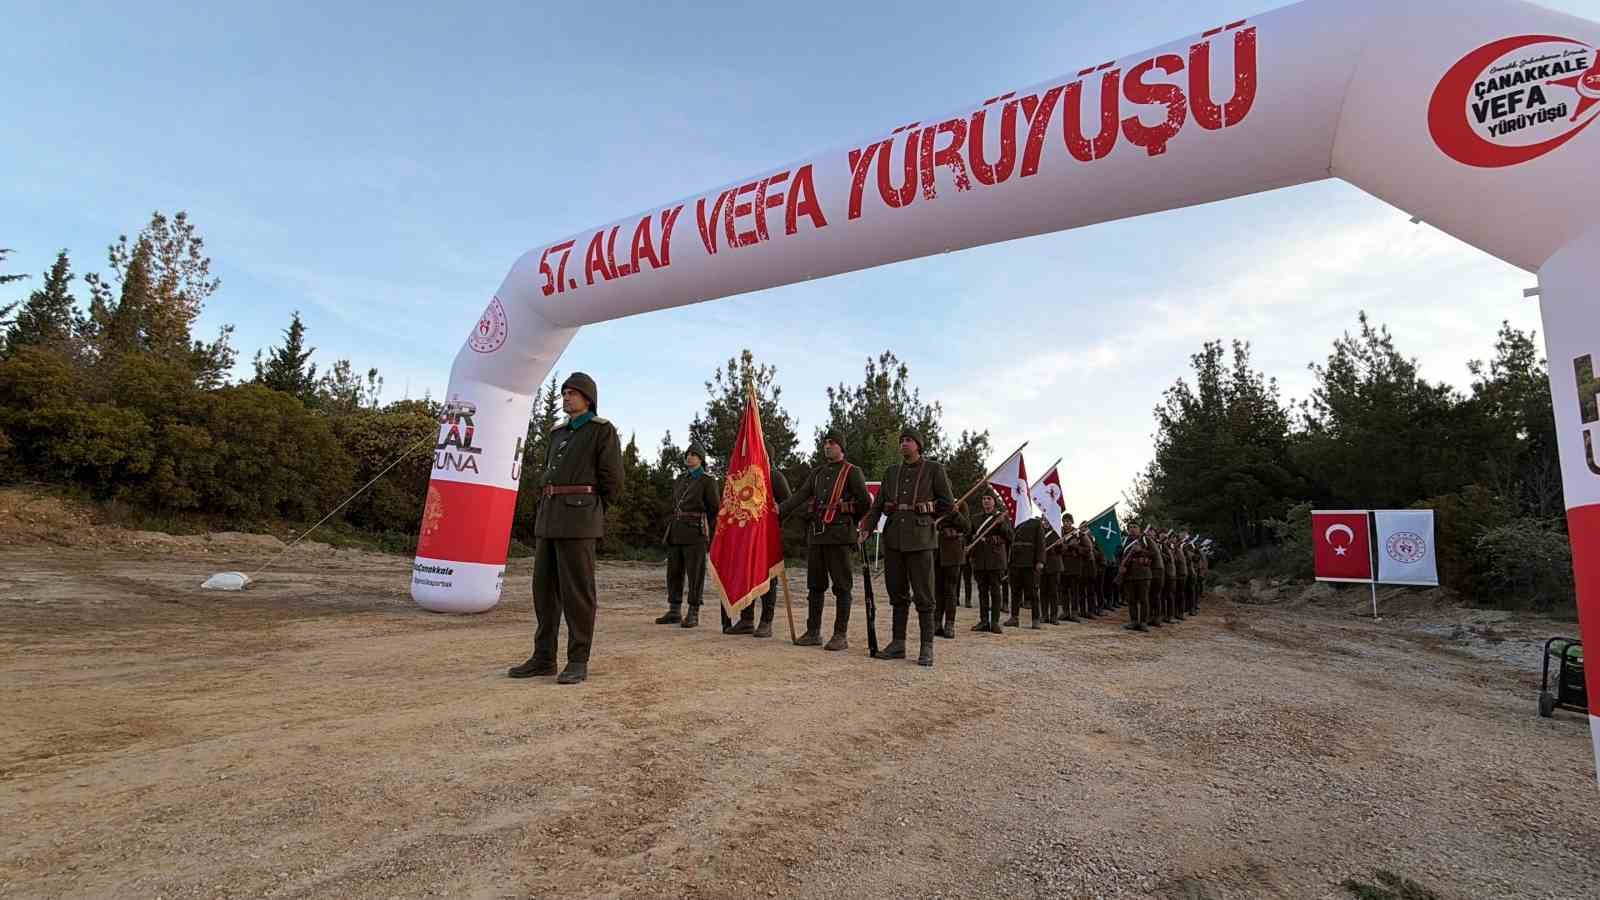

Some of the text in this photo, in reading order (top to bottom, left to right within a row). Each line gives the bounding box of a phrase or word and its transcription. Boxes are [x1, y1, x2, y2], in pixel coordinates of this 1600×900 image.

[1474, 57, 1588, 100] ÇANAKKALE
[1471, 85, 1547, 124] VEFA
[1487, 102, 1568, 138] YÜRÜYÜŞÜ
[538, 20, 1257, 296] 57. ALAY VEFA YÜRÜYÜŞÜ
